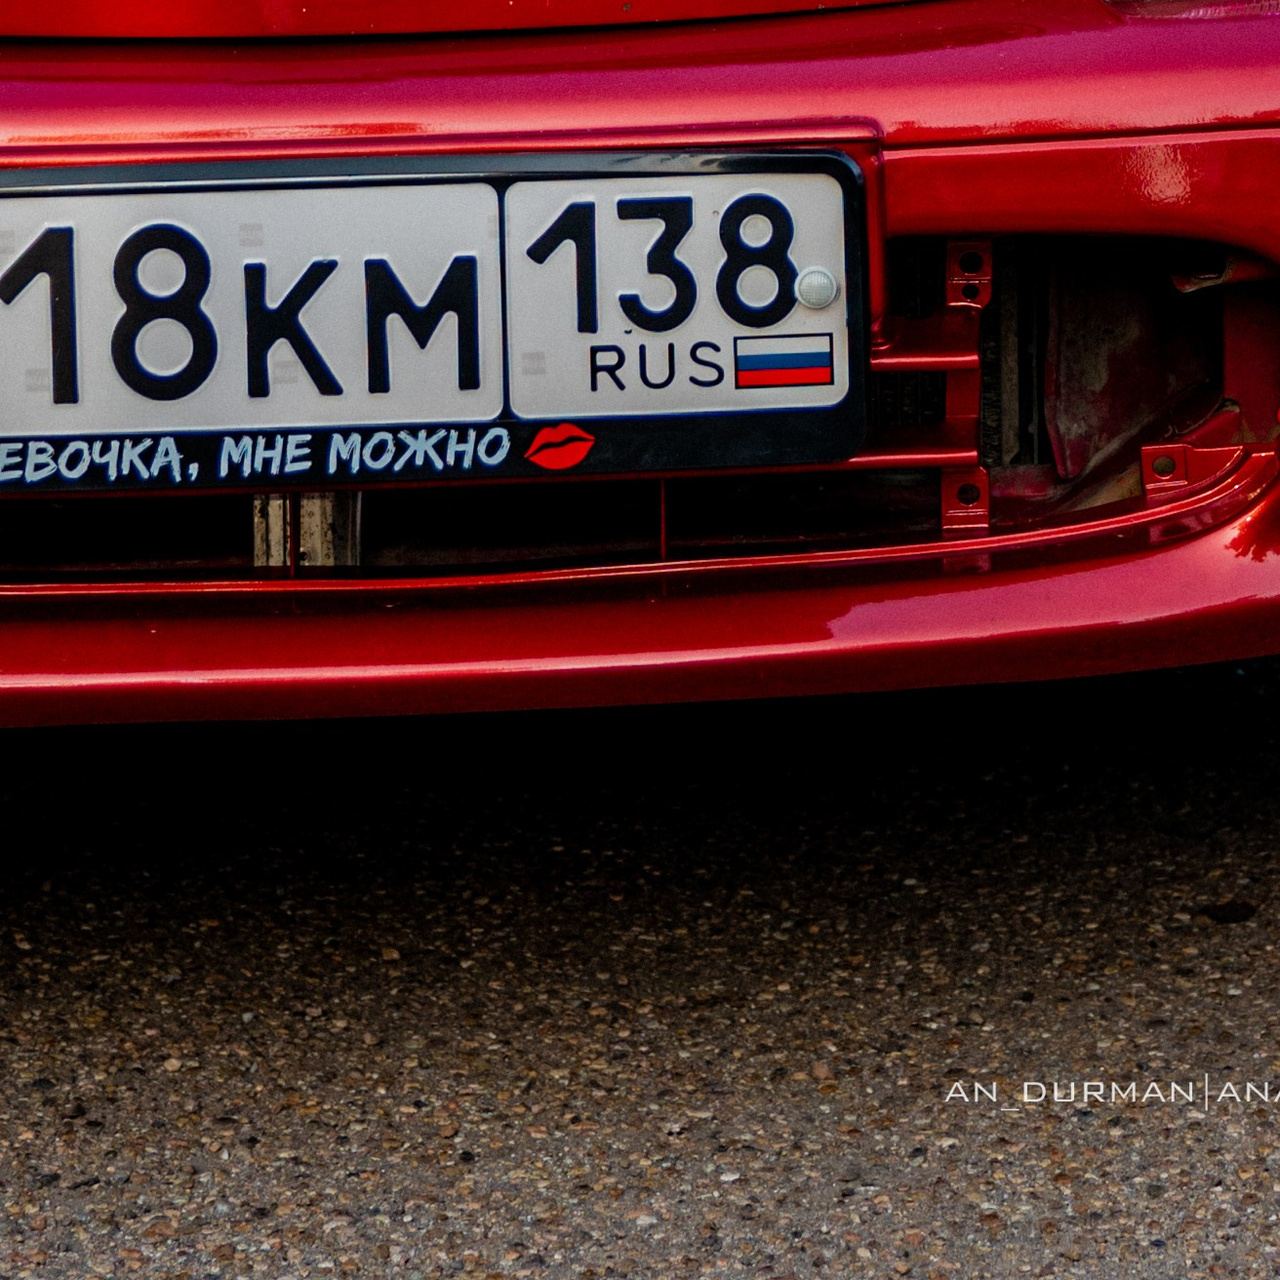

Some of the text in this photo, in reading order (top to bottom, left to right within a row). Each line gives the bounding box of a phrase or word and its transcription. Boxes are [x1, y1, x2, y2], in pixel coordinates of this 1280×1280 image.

[525, 192, 800, 334] 138
[589, 340, 725, 392] RUS
[219, 433, 313, 477] МНЕ
[327, 426, 511, 474] МОЖНО
